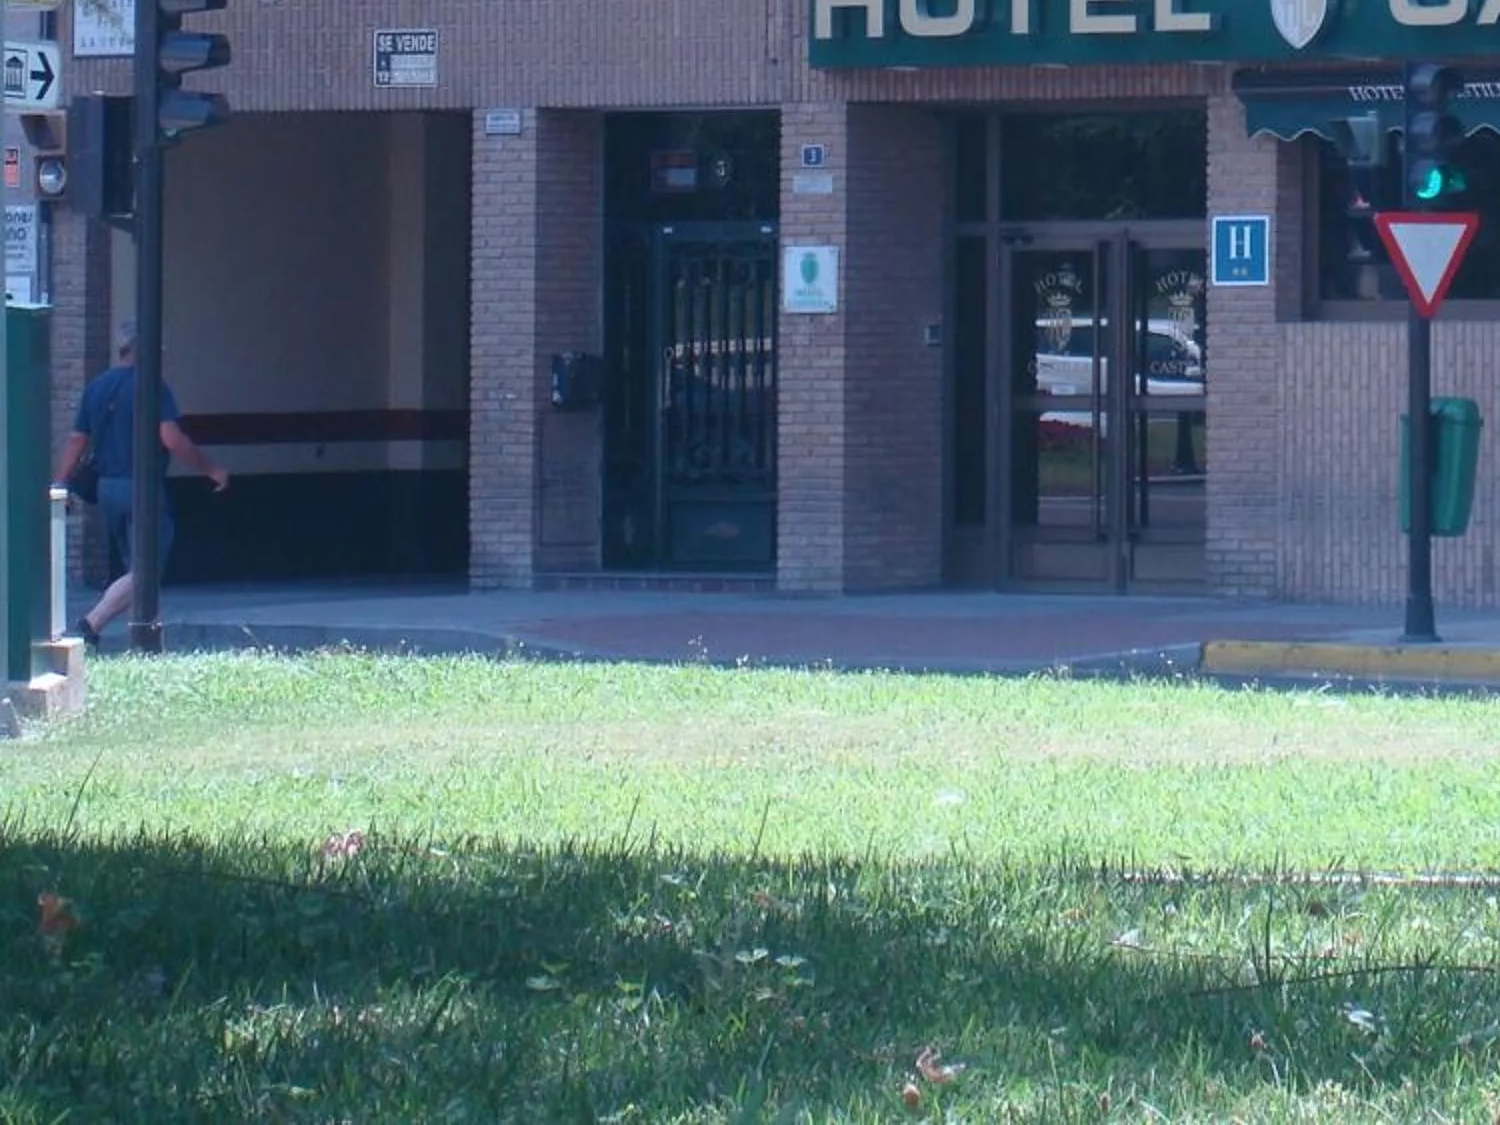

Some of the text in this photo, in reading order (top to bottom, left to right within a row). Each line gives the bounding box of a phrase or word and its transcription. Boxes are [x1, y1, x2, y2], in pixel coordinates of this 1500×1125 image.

[378, 34, 435, 52] SE VENDE
[1349, 84, 1405, 101] HOTE
[1228, 225, 1252, 260] H
